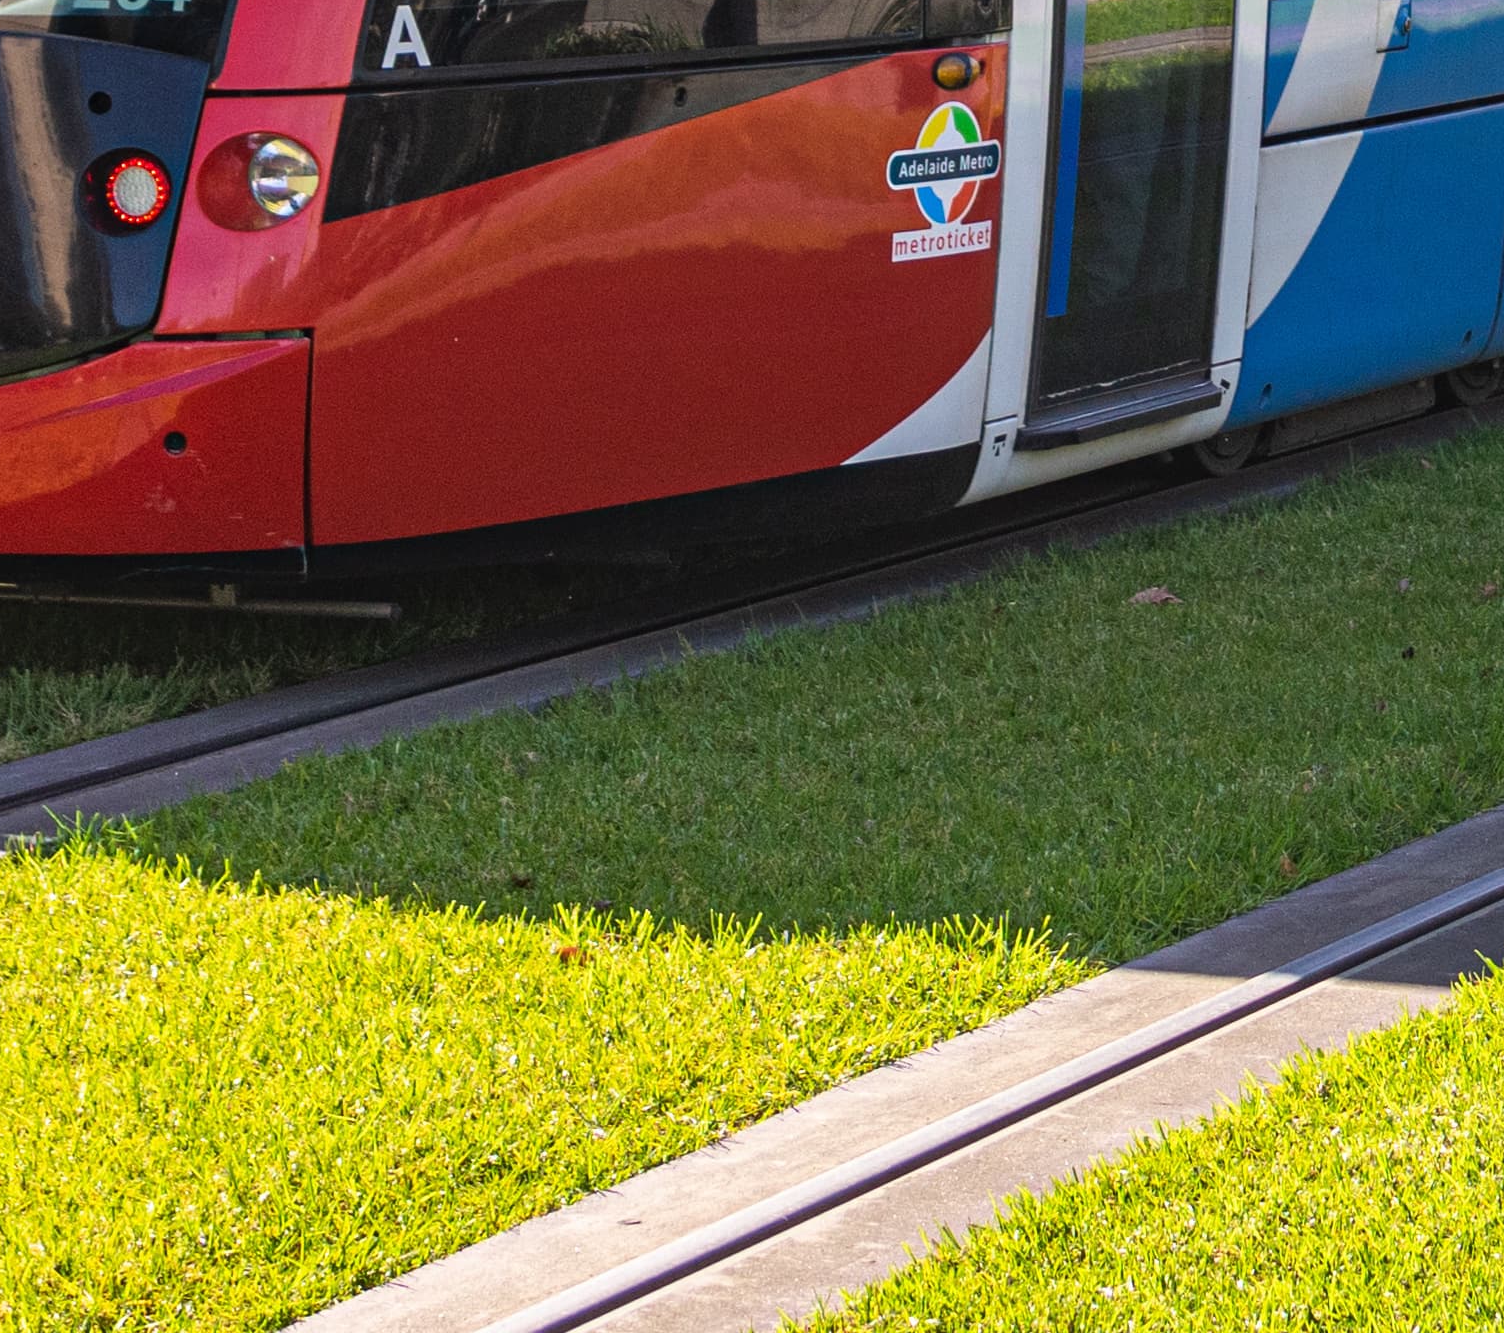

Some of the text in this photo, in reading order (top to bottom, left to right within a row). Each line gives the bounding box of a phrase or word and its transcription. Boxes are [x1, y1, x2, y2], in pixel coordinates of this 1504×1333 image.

[381, 5, 431, 68] A
[898, 154, 993, 179] Adelaide Metro
[894, 228, 990, 256] metroticket
